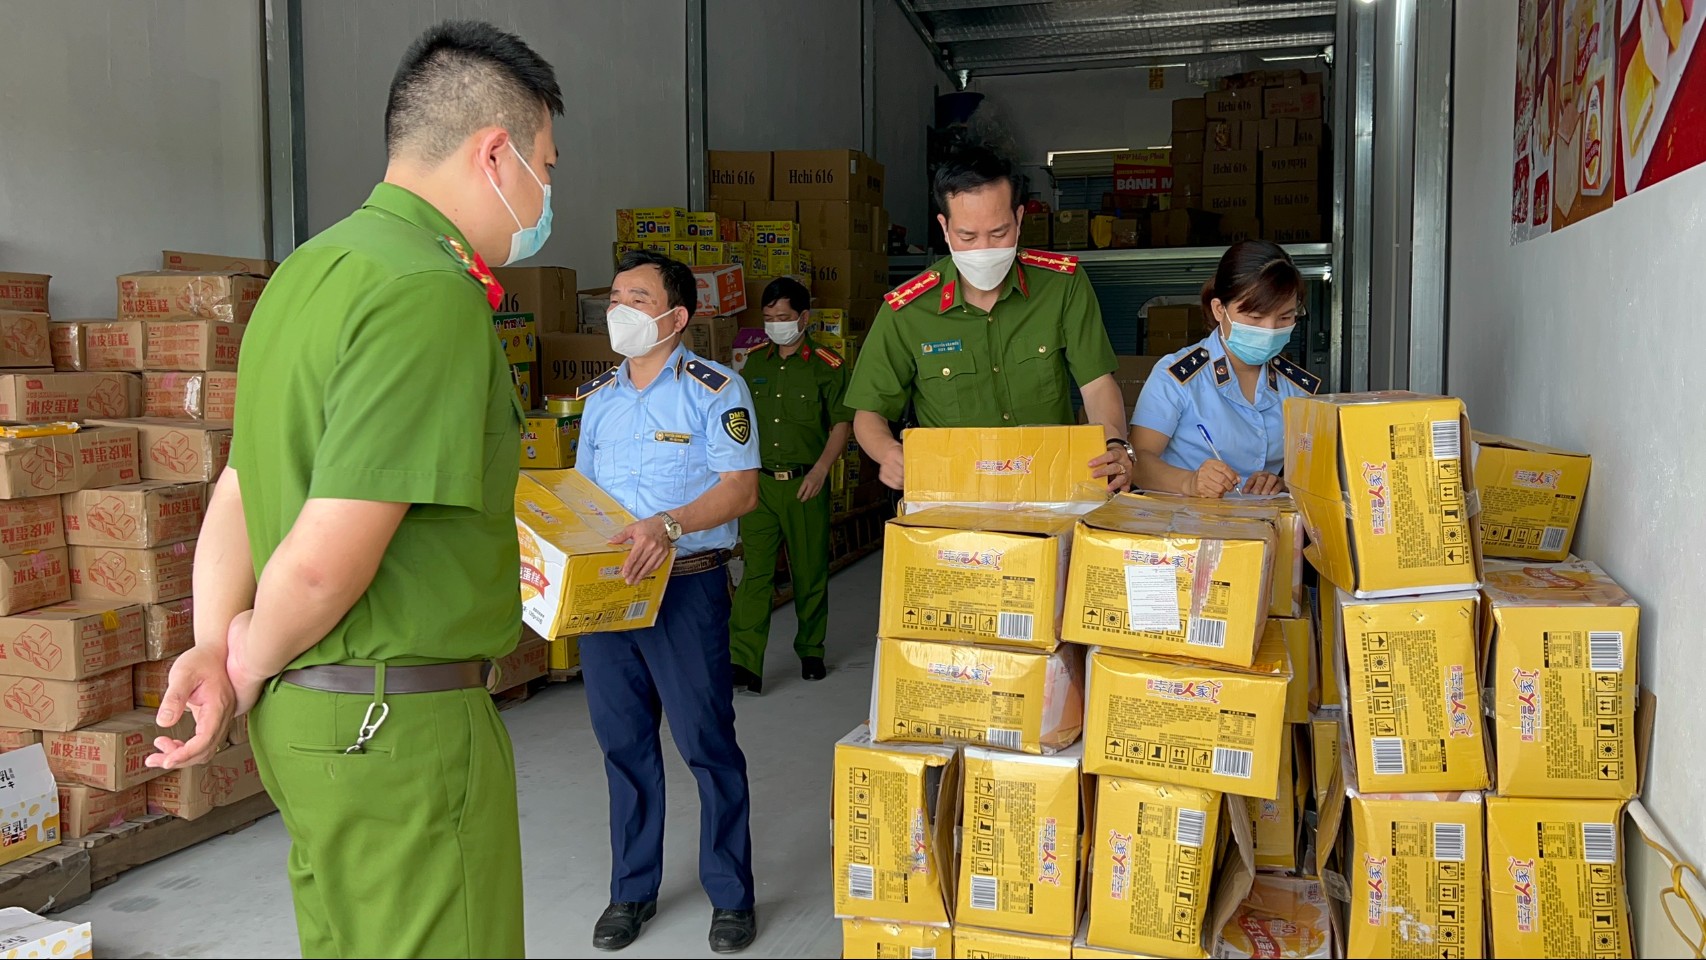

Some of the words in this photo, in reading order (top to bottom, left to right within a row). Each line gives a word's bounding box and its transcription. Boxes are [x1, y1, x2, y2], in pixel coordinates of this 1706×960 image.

[1233, 161, 1248, 172] 616
[712, 168, 736, 185] Hchi
[737, 170, 756, 185] 616
[788, 168, 813, 184] Hchi
[815, 168, 834, 184] 616
[1116, 175, 1157, 190] BÁNH
[818, 266, 838, 282] 616
[122, 298, 169, 313] 冰皮蛋糕
[88, 332, 129, 348] 冰皮蛋糕
[552, 359, 577, 381] 616
[26, 398, 79, 416] 冰皮蛋糕
[728, 411, 745, 420] DMS
[80, 443, 132, 465] 冰皮蛋糕
[158, 497, 201, 518] 冰皮蛋糕
[1, 520, 55, 544] 冰皮蛋糕
[1154, 679, 1211, 698] 幸福人家
[1518, 680, 1536, 736] 幸福人家
[51, 740, 101, 762] 冰皮蛋糕
[1, 819, 24, 836] 豆乳
[2, 830, 28, 847] ケーキ
[1514, 868, 1532, 925] 幸福人家
